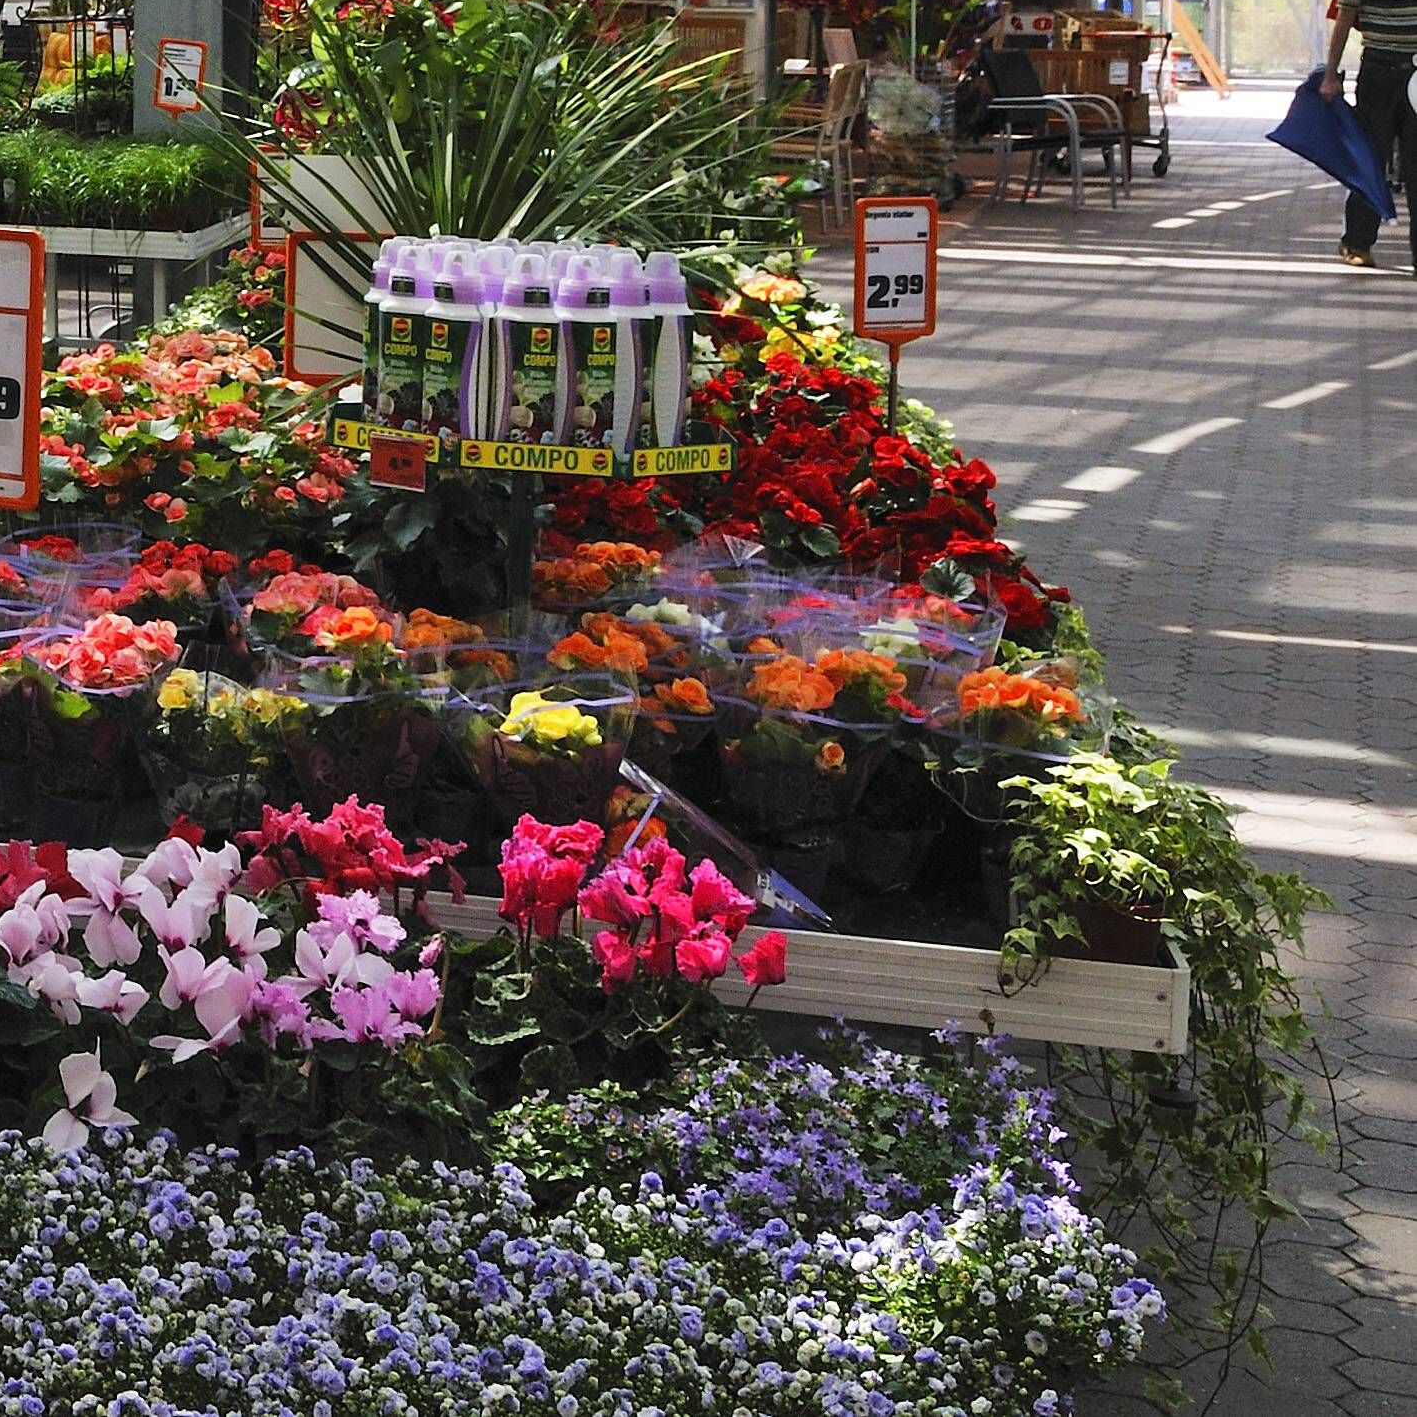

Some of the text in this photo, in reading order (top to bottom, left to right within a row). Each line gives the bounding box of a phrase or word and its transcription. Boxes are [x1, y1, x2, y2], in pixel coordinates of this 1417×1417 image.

[867, 274, 924, 309] 2,99
[384, 342, 418, 357] COMPO
[425, 347, 453, 363] COMPO
[523, 353, 558, 367] COMPO
[587, 353, 615, 366] COMPO
[494, 444, 579, 471] COMPO
[655, 449, 710, 472] COMPO
